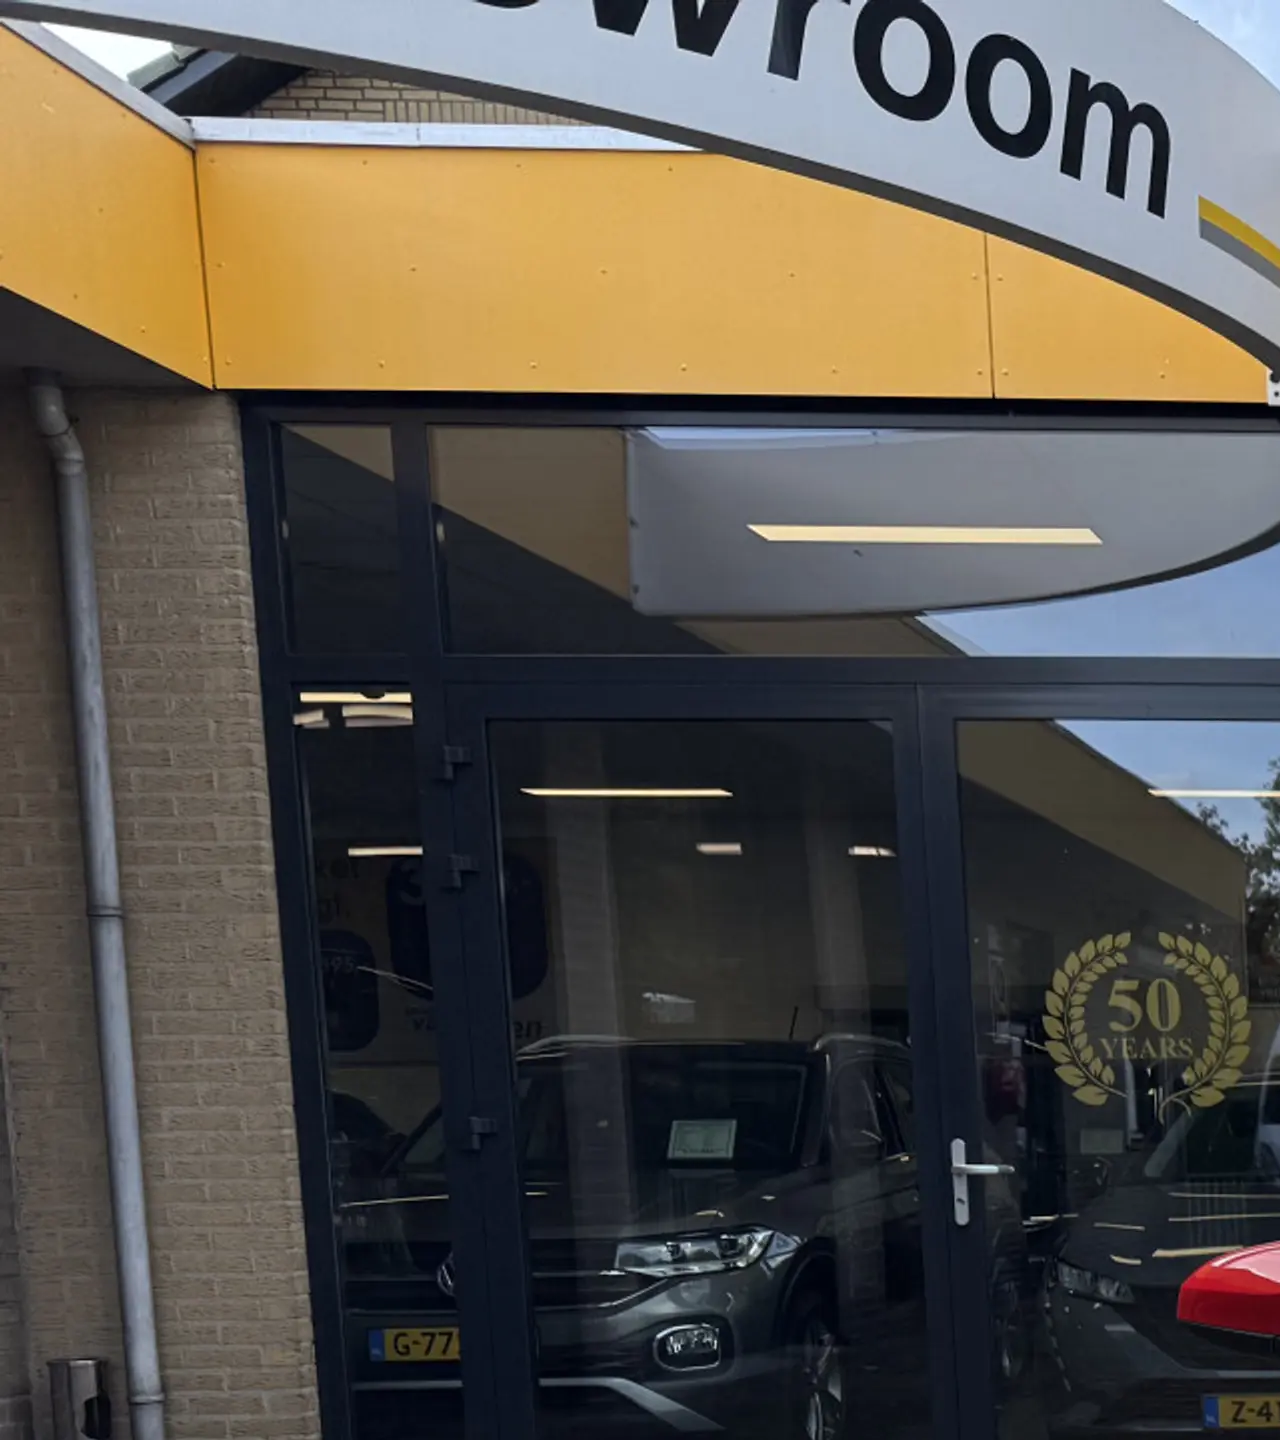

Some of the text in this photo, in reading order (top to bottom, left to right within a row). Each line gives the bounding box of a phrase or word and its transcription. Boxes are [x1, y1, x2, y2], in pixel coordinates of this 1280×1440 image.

[468, 0, 1173, 220] room
[1107, 977, 1182, 1033] 50
[1099, 1037, 1194, 1060] YEARS
[393, 1331, 460, 1356] G-77
